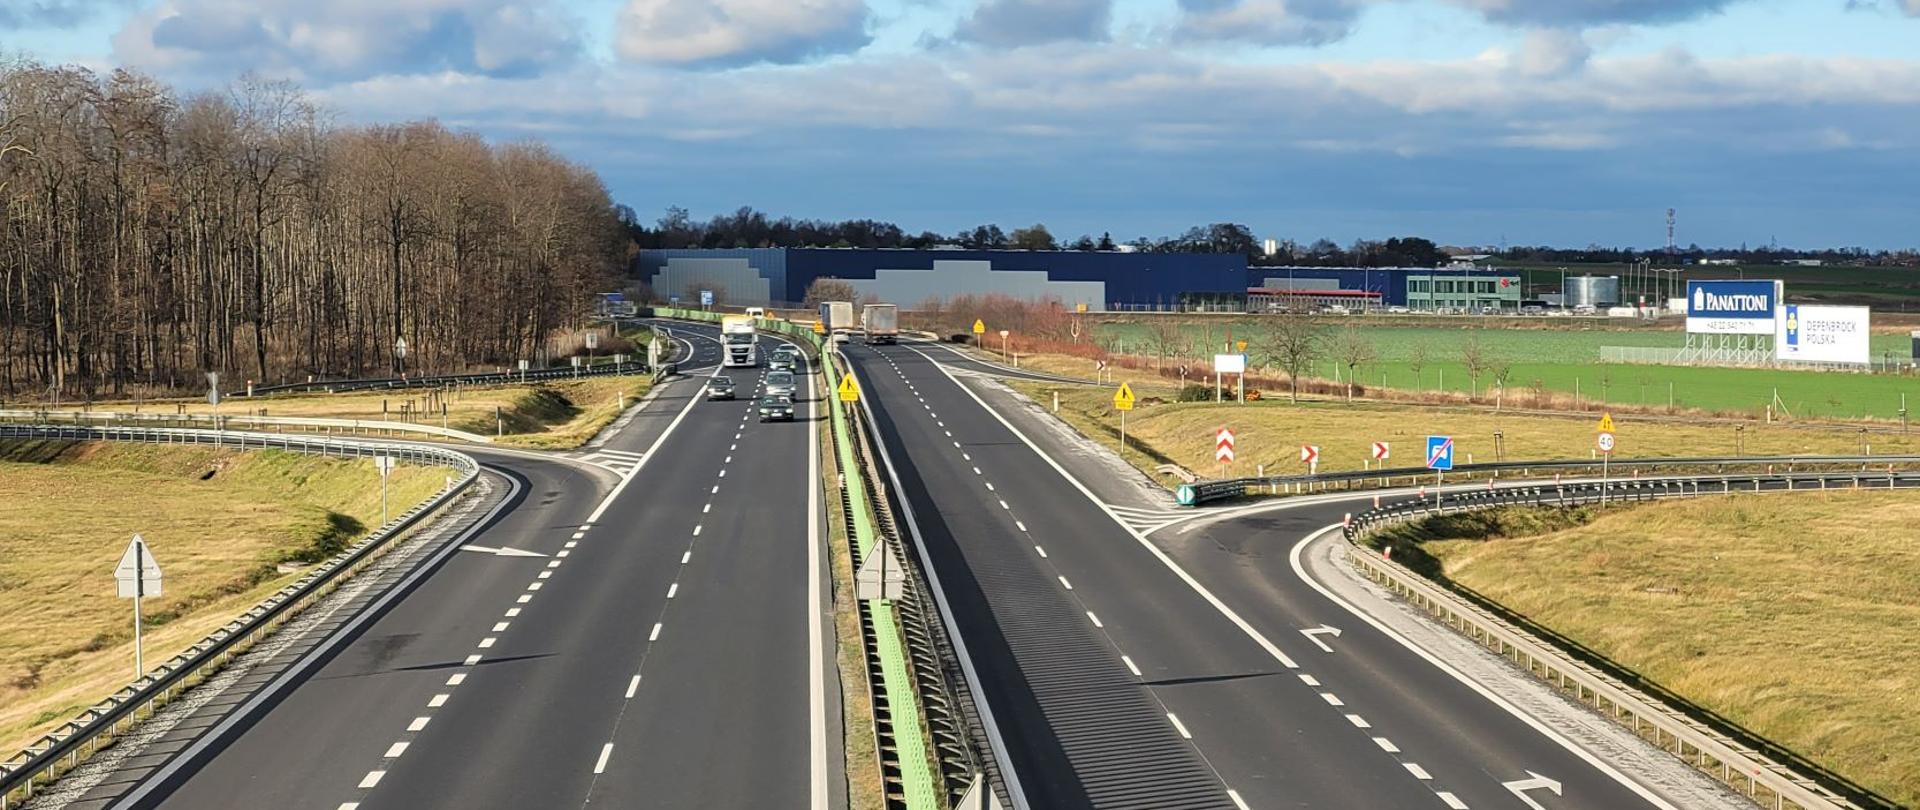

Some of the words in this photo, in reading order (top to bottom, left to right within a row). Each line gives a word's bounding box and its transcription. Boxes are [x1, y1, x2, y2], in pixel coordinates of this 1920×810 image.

[1706, 292, 1768, 311] PANATTONI
[1806, 320, 1856, 332] DEPENBROCK
[1806, 334, 1835, 345] POLSKA
[1600, 437, 1612, 447] 40
